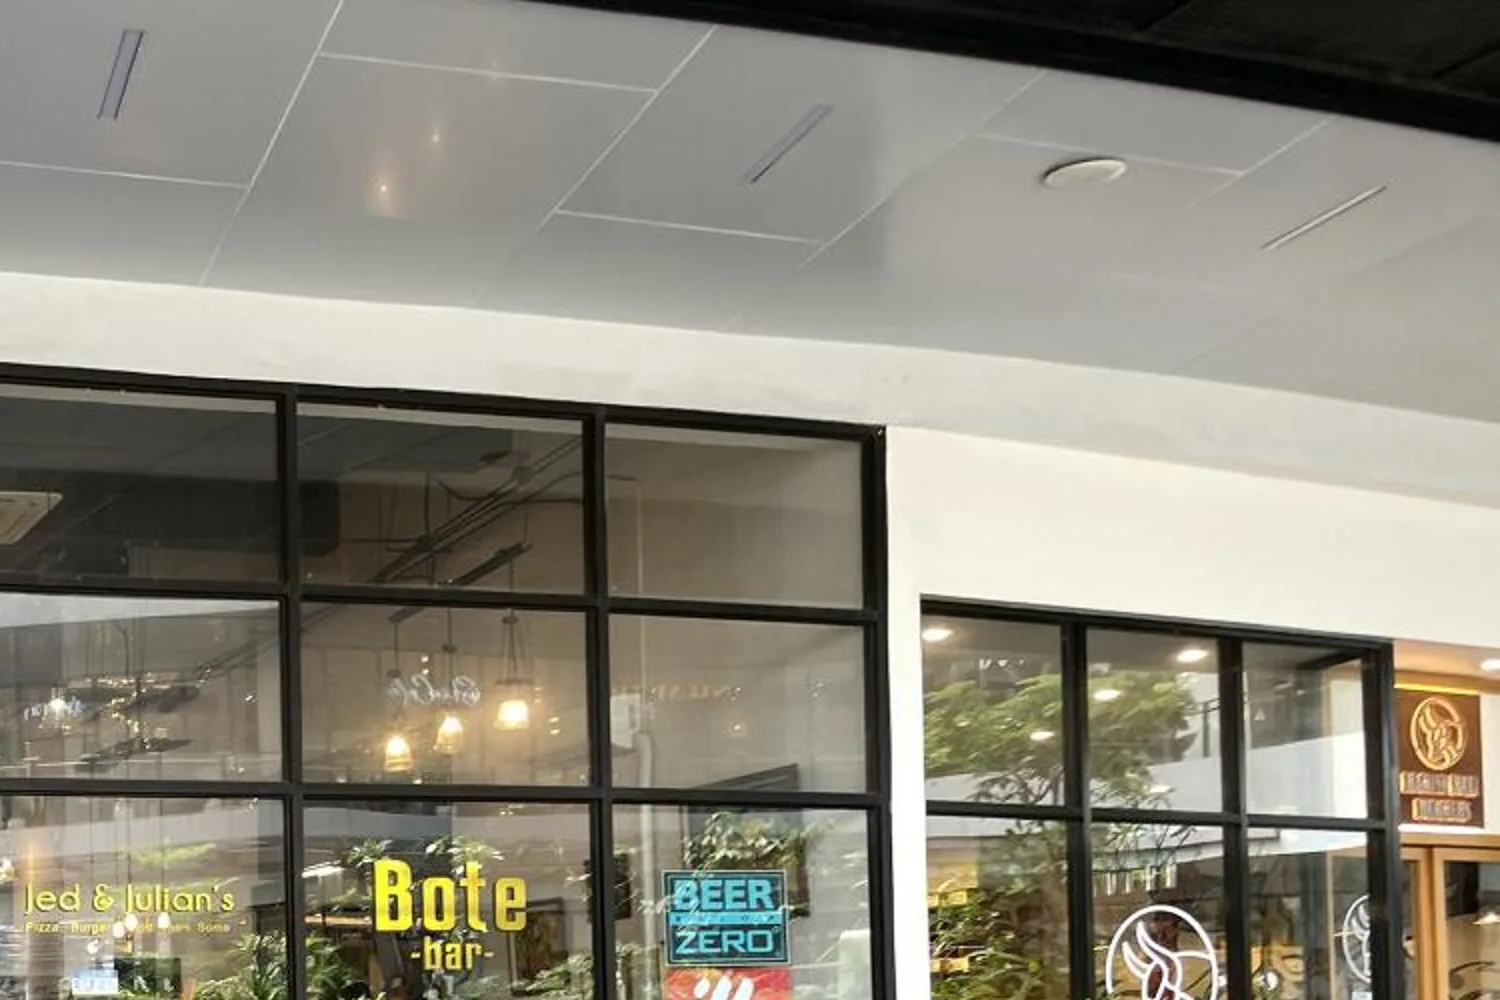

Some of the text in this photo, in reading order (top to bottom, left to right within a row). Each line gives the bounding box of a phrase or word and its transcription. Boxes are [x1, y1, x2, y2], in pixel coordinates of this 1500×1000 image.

[24, 883, 236, 916] Jed & Julian's
[374, 858, 527, 932] Bote
[674, 879, 775, 911] BEER
[676, 928, 773, 955] ZERO
